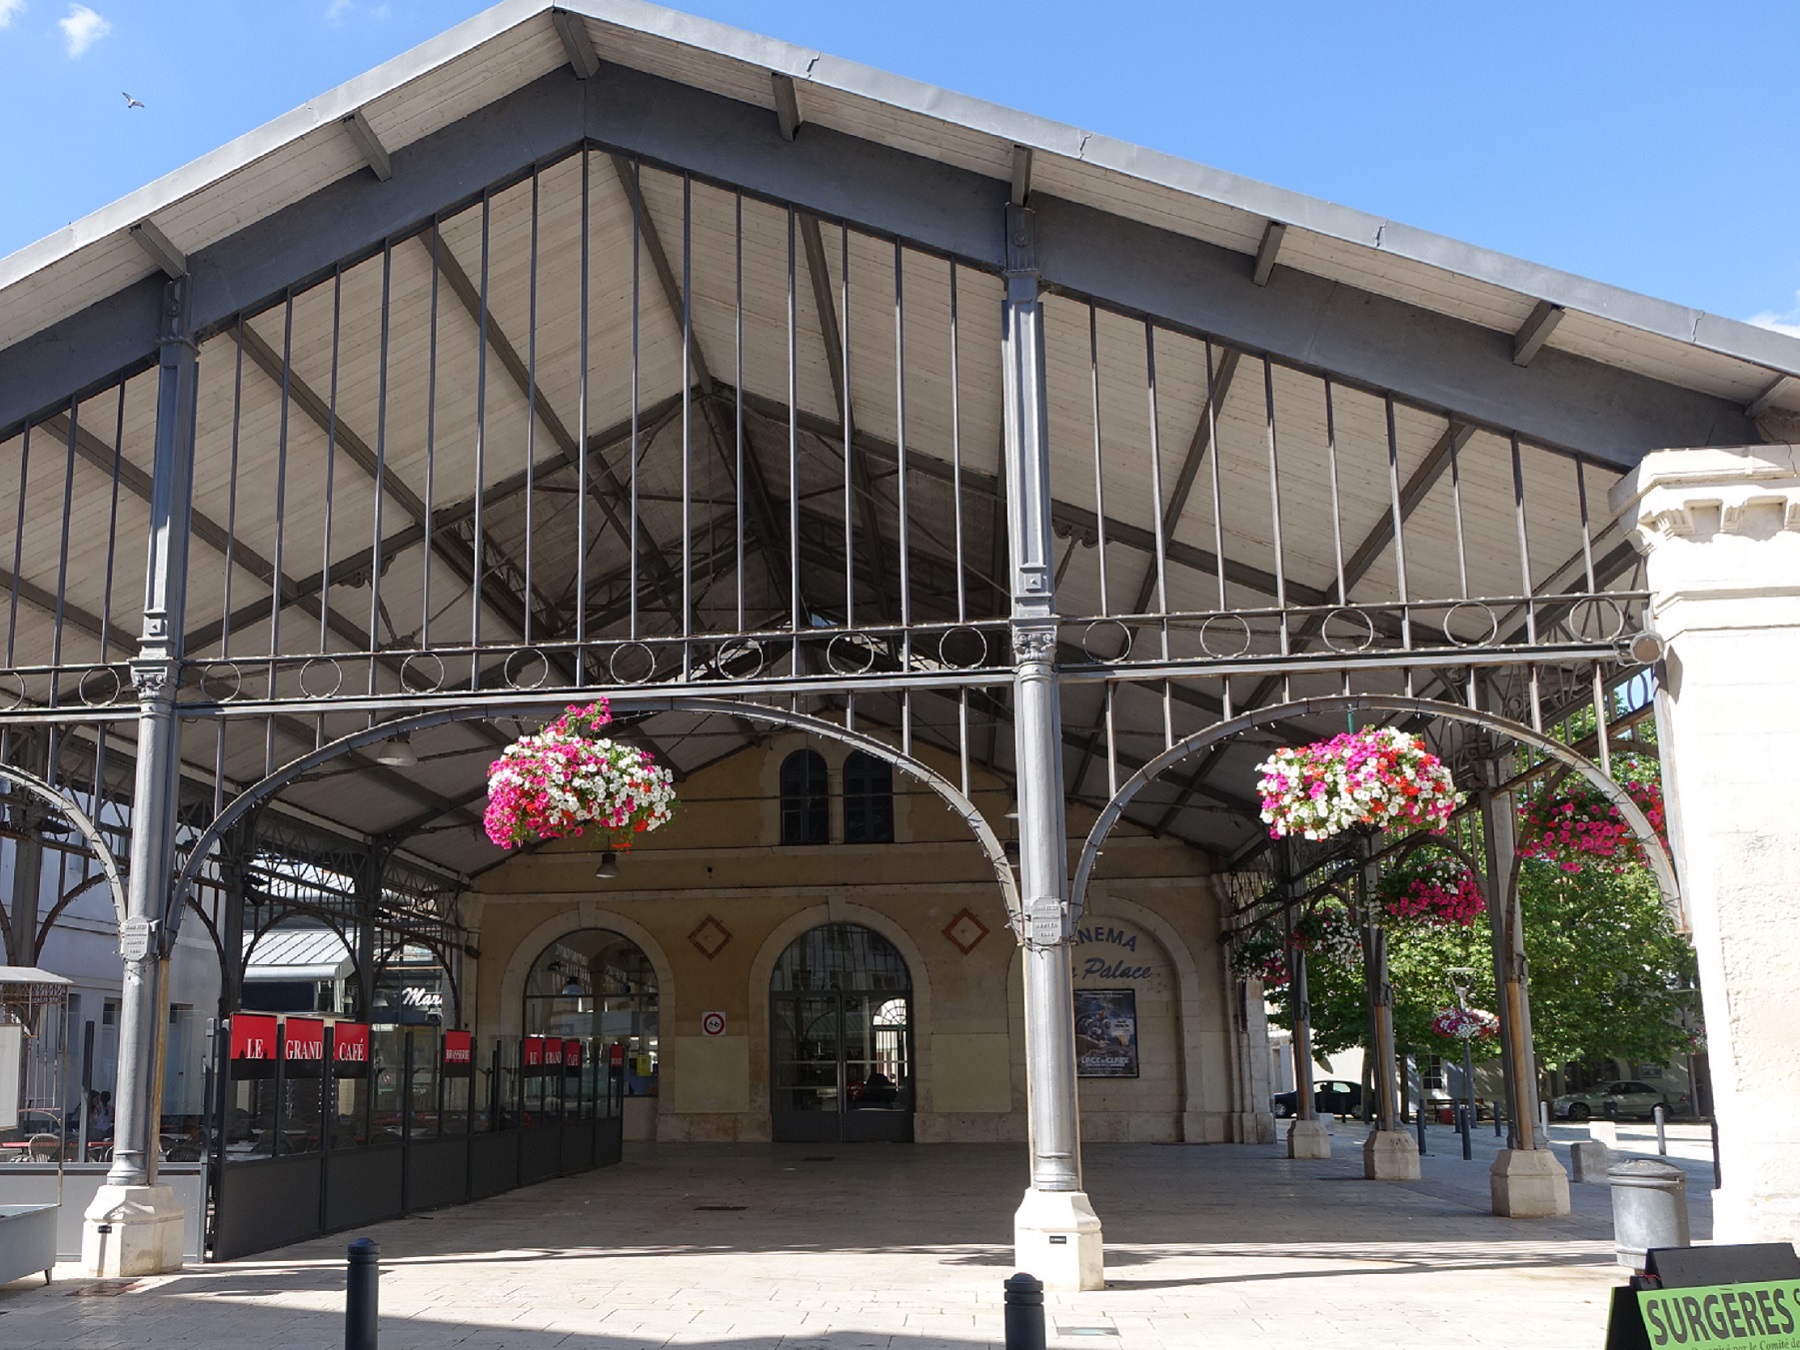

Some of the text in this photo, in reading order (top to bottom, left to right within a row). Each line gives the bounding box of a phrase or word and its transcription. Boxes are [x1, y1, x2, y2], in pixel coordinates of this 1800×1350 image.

[1077, 926, 1137, 952] NEMA
[1082, 957, 1152, 980] Palace
[246, 1037, 364, 1061] LE GRAND CAFÉ
[530, 1051, 538, 1065] LE
[1646, 1287, 1795, 1346] SURGÈRES
[1760, 1338, 1790, 1350] Comité
